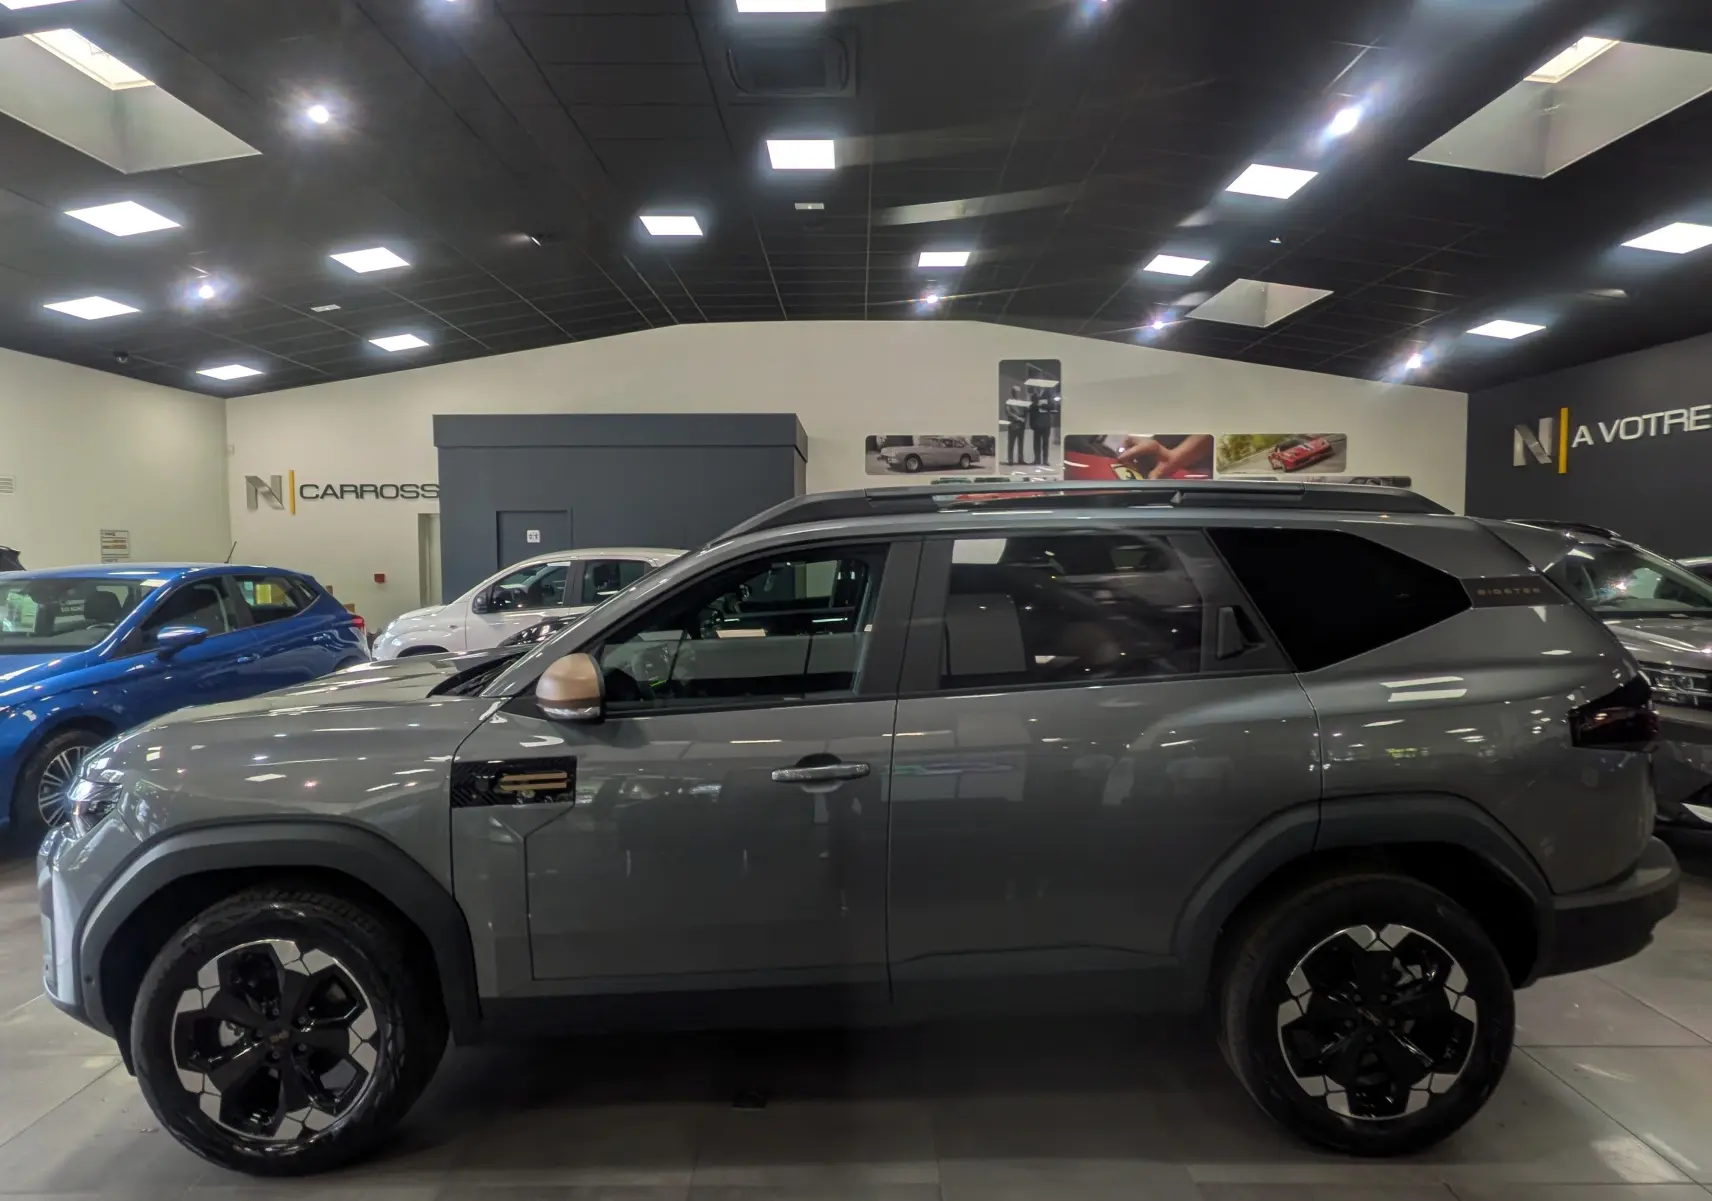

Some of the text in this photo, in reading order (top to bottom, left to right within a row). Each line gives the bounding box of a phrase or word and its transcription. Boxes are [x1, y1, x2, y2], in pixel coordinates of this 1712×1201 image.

[1571, 425, 1595, 448] A
[1598, 404, 1712, 443] VOTRE
[299, 483, 440, 500] CARROSS
